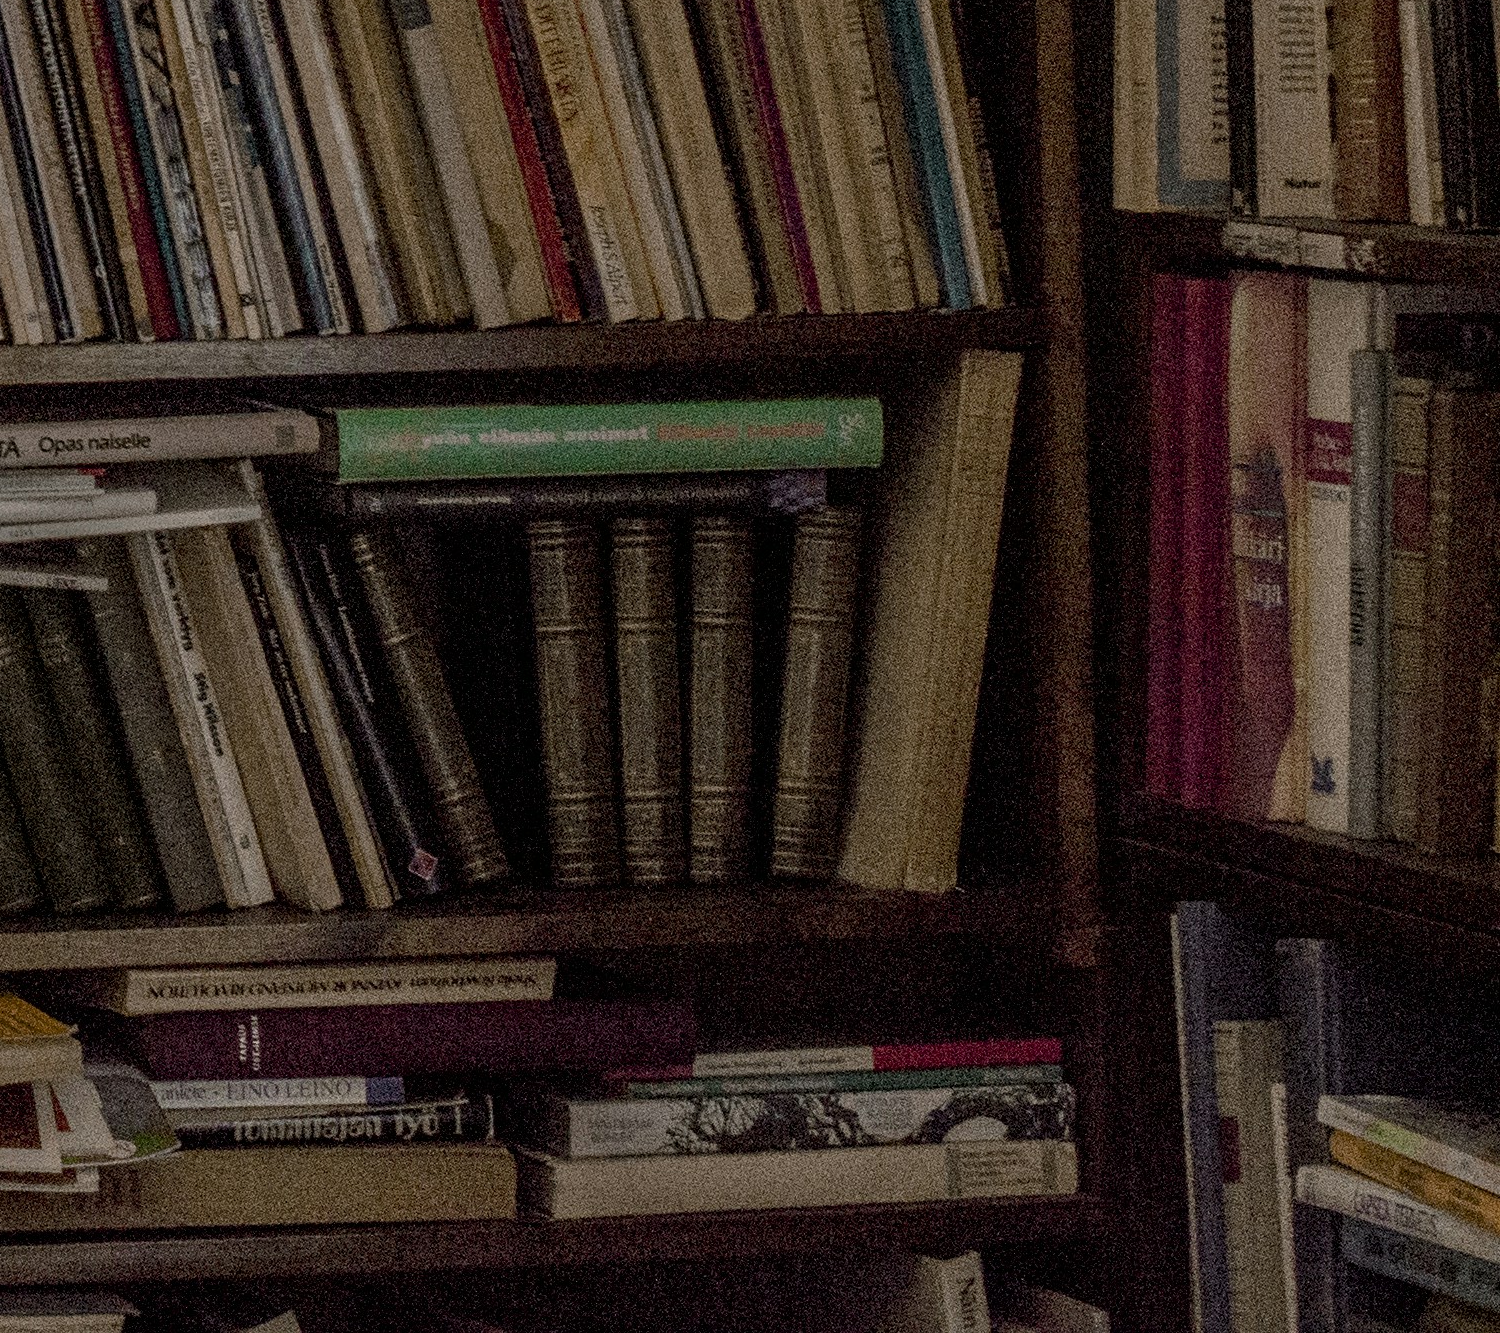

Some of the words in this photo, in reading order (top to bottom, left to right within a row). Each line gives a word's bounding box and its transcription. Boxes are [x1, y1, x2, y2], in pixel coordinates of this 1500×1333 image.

[591, 204, 617, 251] Joseph
[38, 437, 83, 458] Opas
[88, 433, 152, 451] naiselle
[192, 672, 211, 701] Stig
[147, 981, 247, 999] REVOLUTION
[225, 1082, 281, 1099] EINO
[285, 1080, 352, 1098] LEINO
